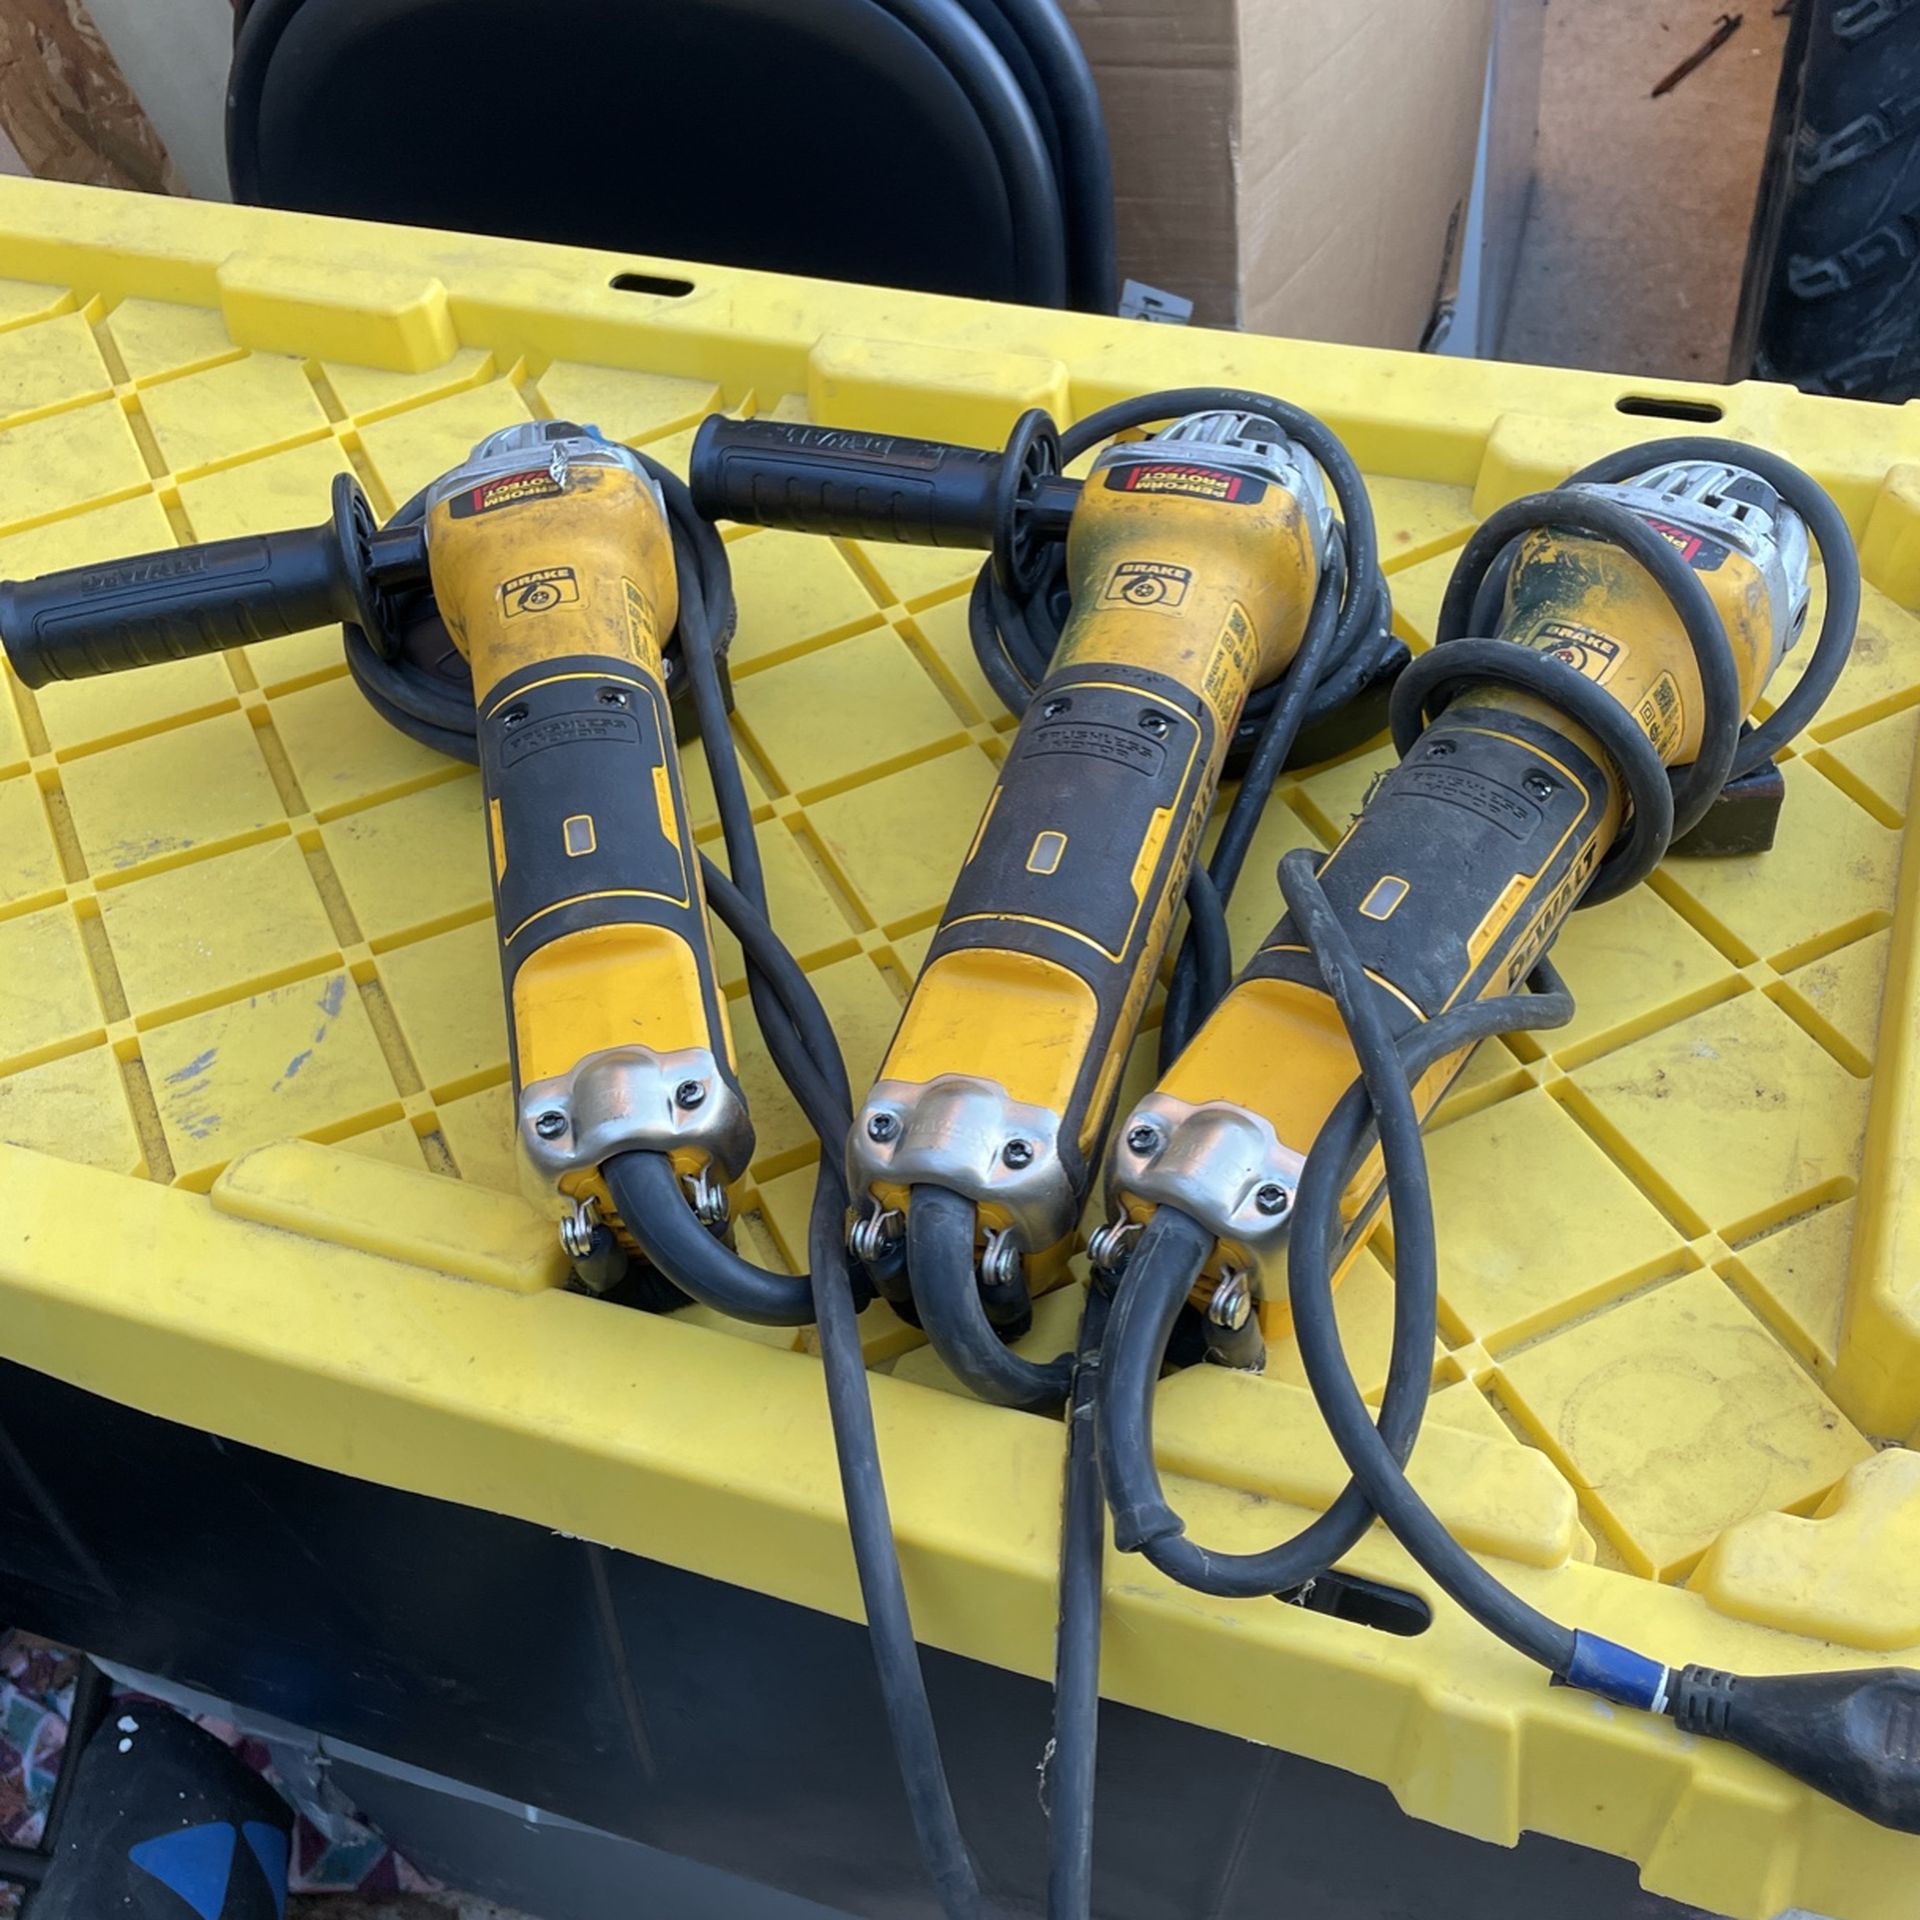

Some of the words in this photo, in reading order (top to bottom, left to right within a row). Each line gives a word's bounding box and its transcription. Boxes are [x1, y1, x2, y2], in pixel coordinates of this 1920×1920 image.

[1135, 482, 1227, 498] PERFORM
[505, 568, 570, 591] BRAKE
[1121, 565, 1188, 578] BRAKE
[1545, 626, 1615, 653] BRAKE
[1507, 840, 1598, 991] DEWALT
